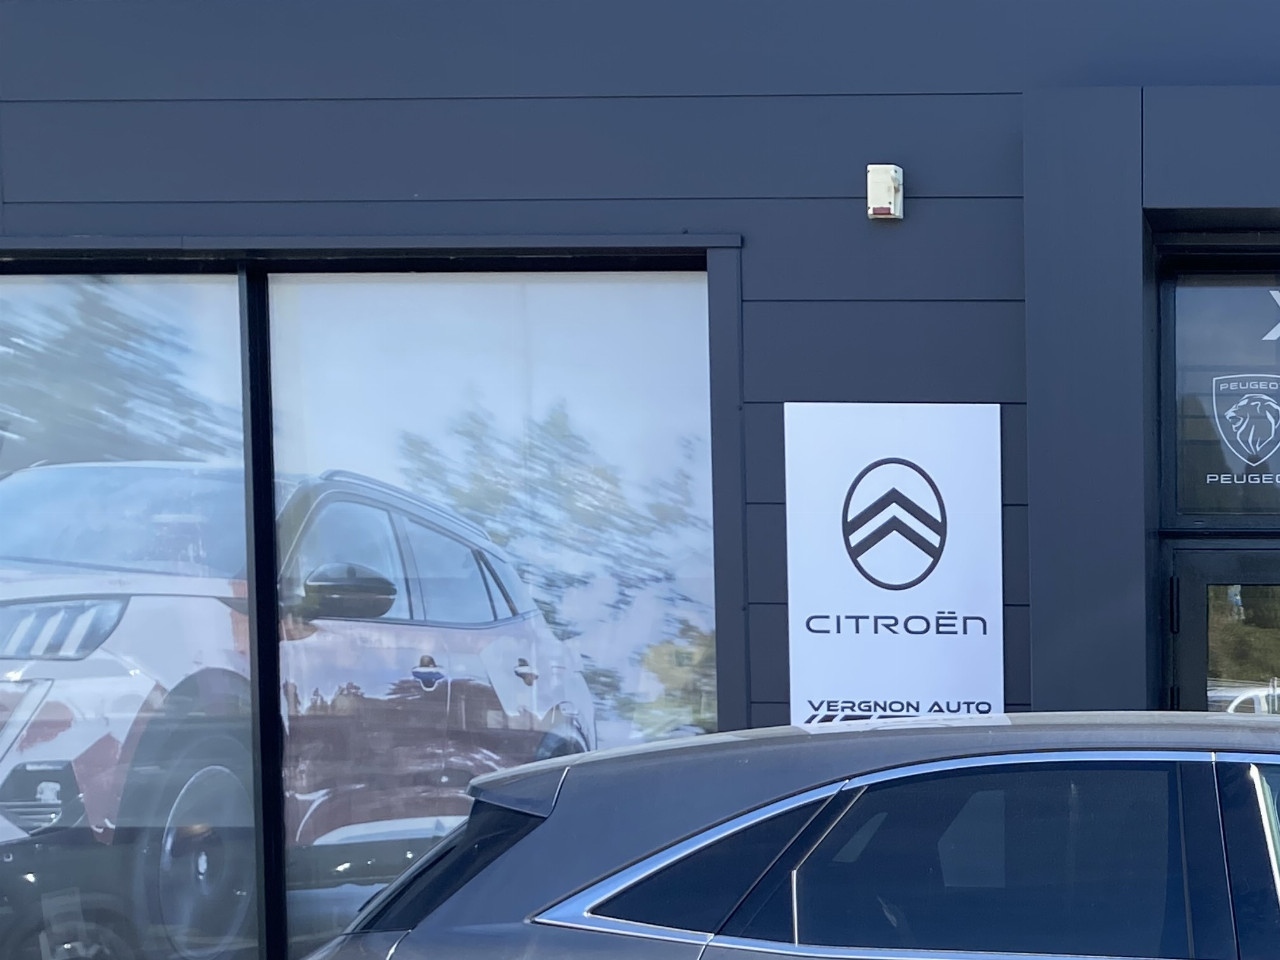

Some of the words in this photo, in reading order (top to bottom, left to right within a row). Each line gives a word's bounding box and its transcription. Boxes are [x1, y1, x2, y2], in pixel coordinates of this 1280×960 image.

[805, 611, 988, 636] CITROËN
[807, 700, 920, 713] VERGNON
[927, 701, 993, 714] AUTO
